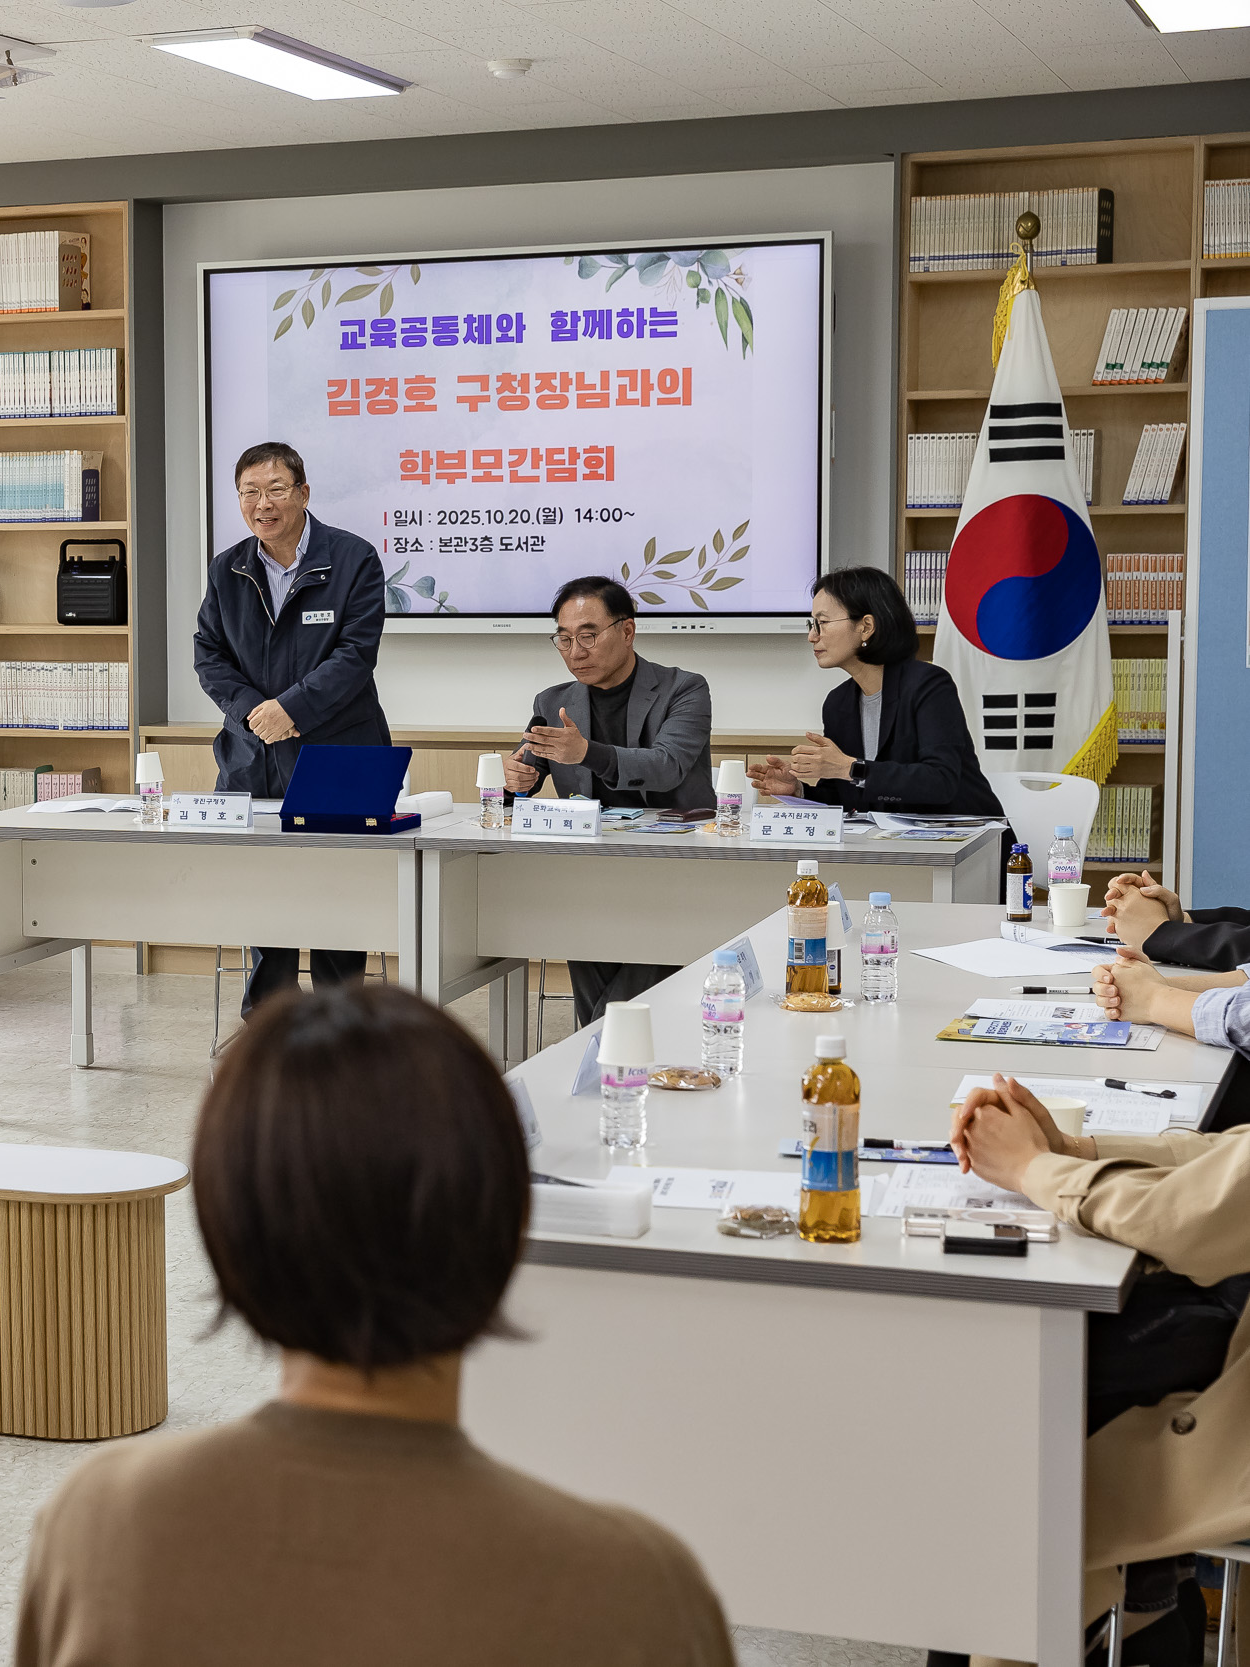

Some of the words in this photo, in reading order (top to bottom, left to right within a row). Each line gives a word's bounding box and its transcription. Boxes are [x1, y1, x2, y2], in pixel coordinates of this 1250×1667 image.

[339, 311, 526, 351] 교육공동체와
[550, 306, 678, 343] 함께하는
[326, 375, 439, 417] 김경호
[456, 367, 693, 412] 구청장님과의
[399, 445, 615, 485] 학부모간담회
[393, 509, 423, 527] 일시
[437, 506, 564, 527] 2025.10.20.(월)
[574, 507, 636, 524] 14:00~
[393, 536, 424, 554] 장소
[438, 535, 494, 554] 본관3층
[498, 534, 546, 553] 도서관
[193, 797, 226, 806] 광진구청장
[179, 810, 227, 821] 김경호
[772, 811, 819, 820] 교육지원과장
[761, 825, 816, 837] 문효정
